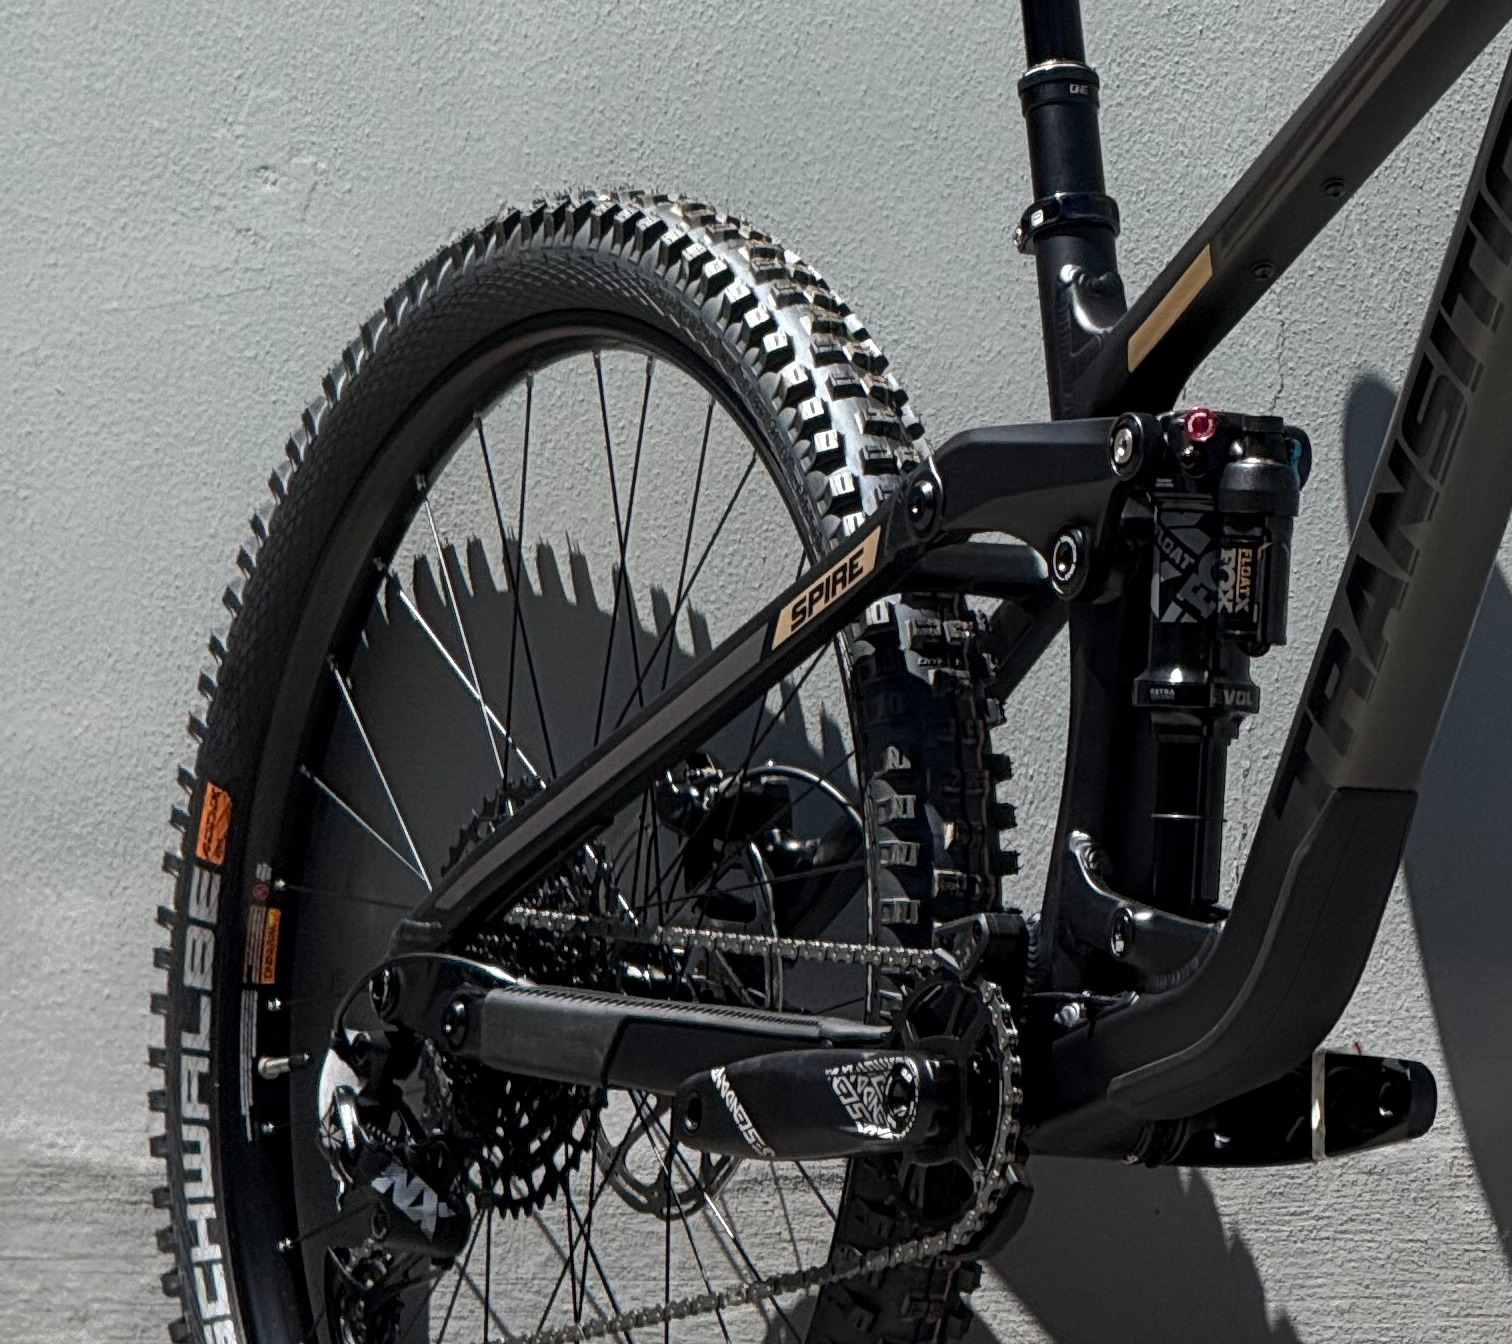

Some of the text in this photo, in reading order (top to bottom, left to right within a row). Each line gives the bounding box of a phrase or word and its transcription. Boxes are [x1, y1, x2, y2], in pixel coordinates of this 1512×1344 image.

[1156, 528, 1197, 570] LOAT
[1239, 547, 1254, 595] FLOAT
[790, 547, 864, 633] SPIRE
[1217, 547, 1236, 615] FOX
